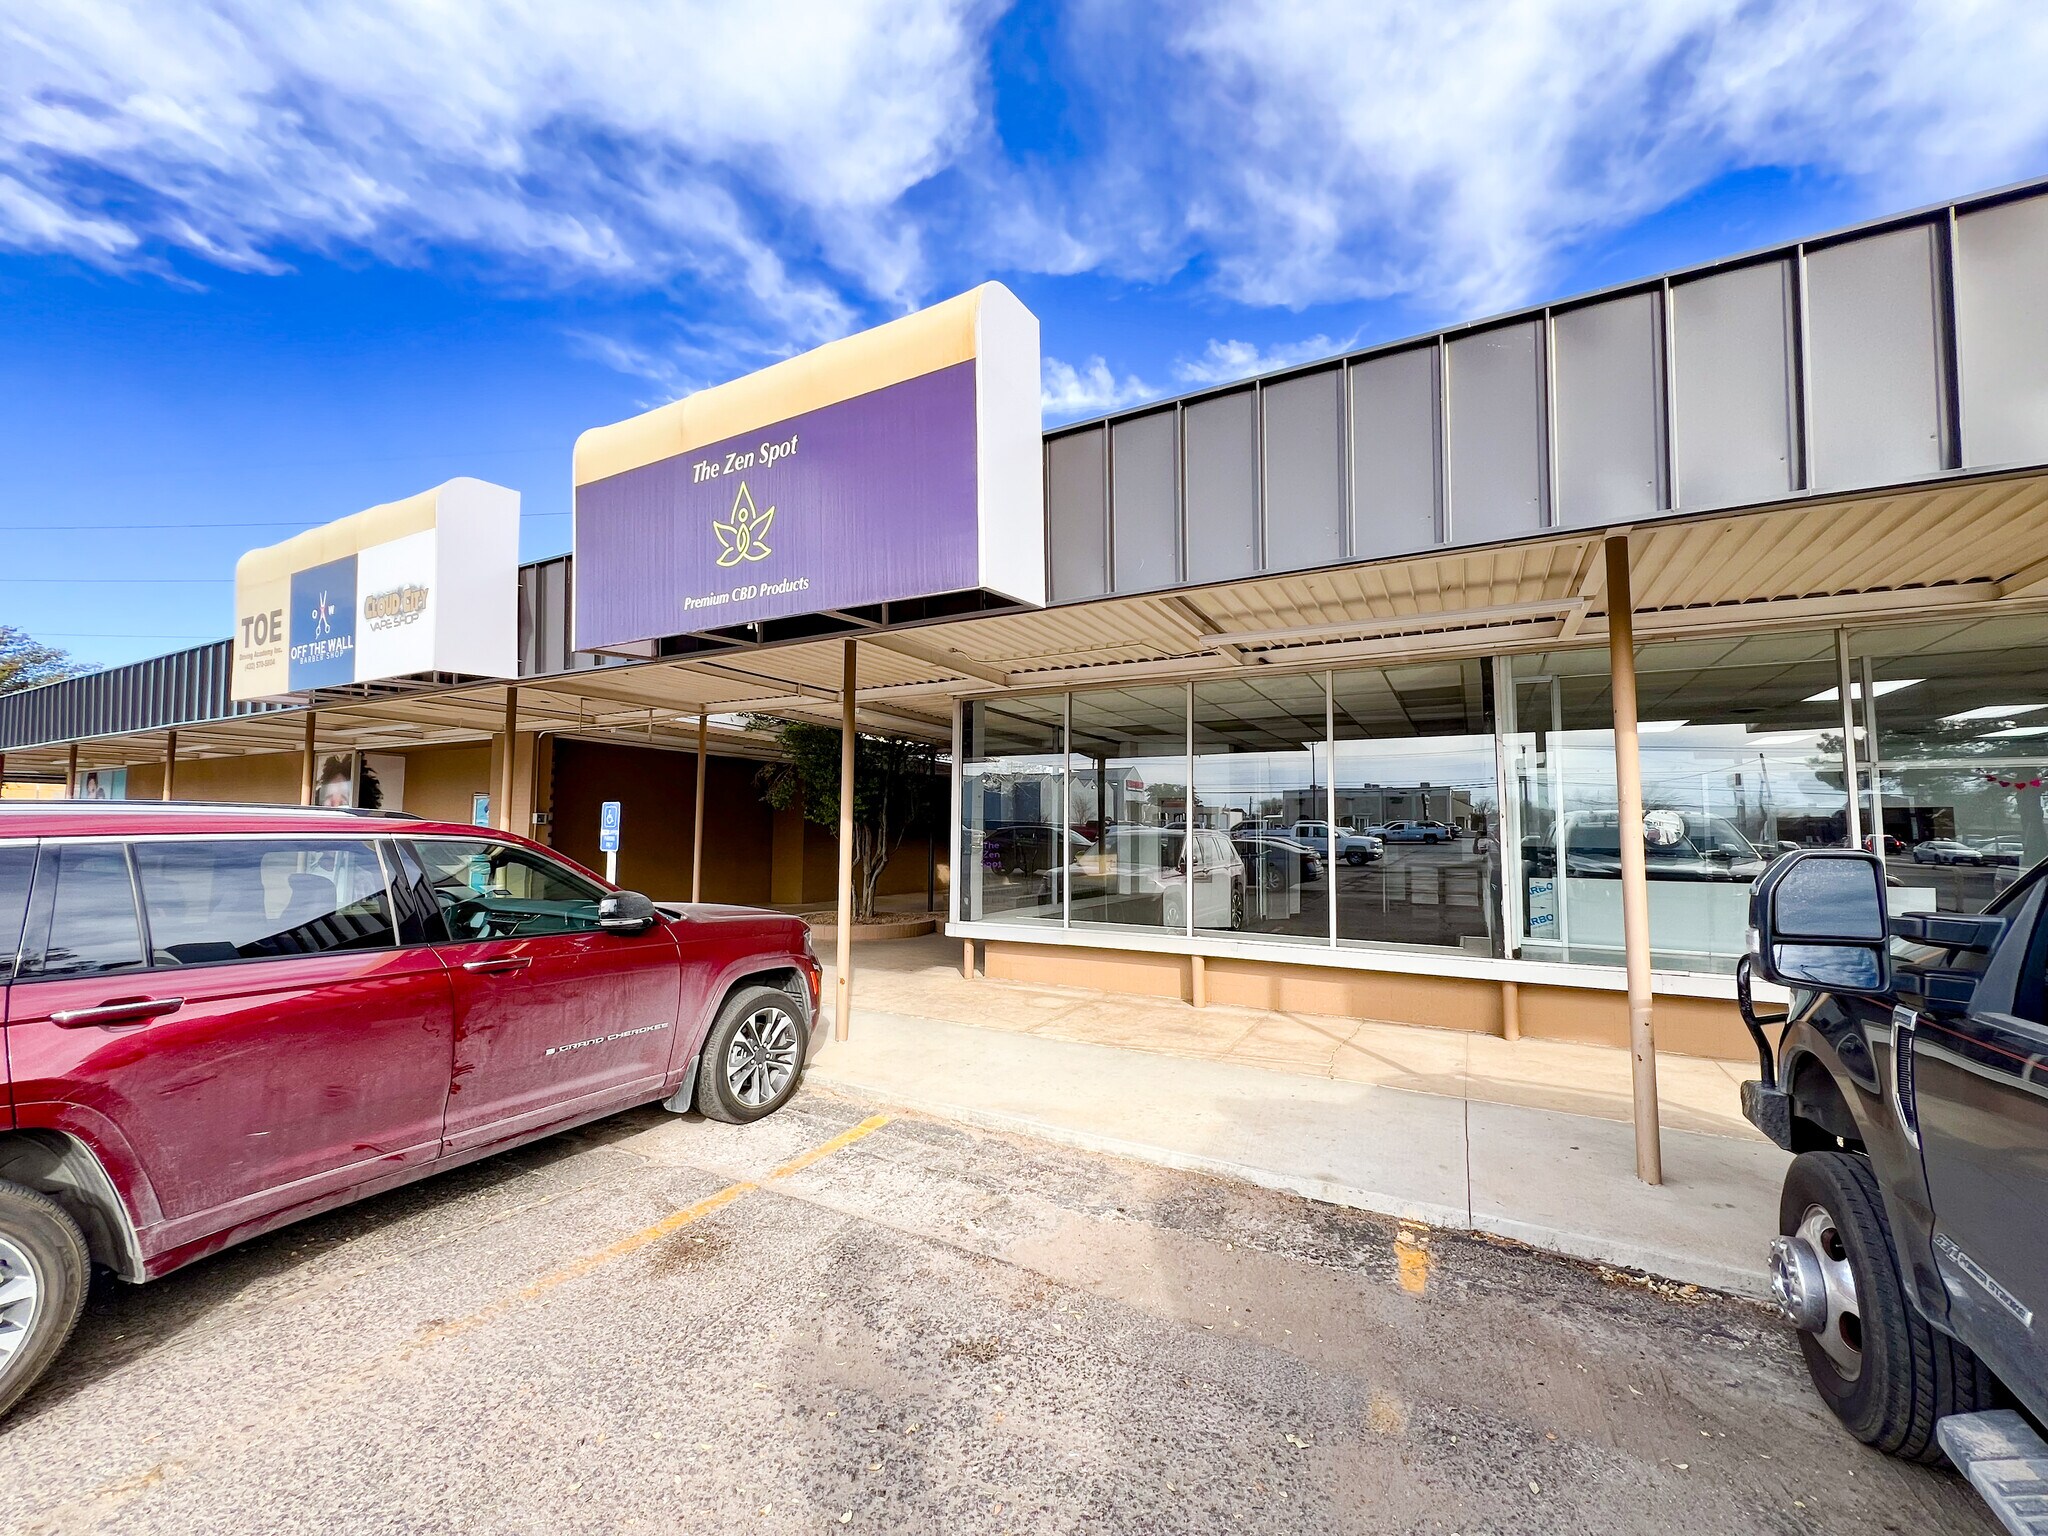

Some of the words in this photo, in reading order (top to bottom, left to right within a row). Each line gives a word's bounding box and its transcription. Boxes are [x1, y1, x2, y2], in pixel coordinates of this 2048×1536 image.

[693, 460, 719, 483] The
[723, 451, 755, 475] Zen
[759, 434, 799, 468] Spot
[684, 592, 729, 611] Premium
[732, 585, 757, 602] CBD
[759, 576, 809, 597] Products
[241, 609, 282, 648] TOE
[370, 619, 393, 632] VAPE
[393, 613, 419, 628] SHOP
[290, 644, 308, 660] OFF
[309, 641, 326, 656] THE
[328, 635, 354, 652] WALL
[300, 653, 323, 665] BARBER
[326, 649, 344, 660] SHOP
[983, 841, 1000, 849] The
[983, 851, 1000, 859] Zen
[559, 1037, 605, 1052] GRAND
[607, 1022, 669, 1041] CHEROKEE
